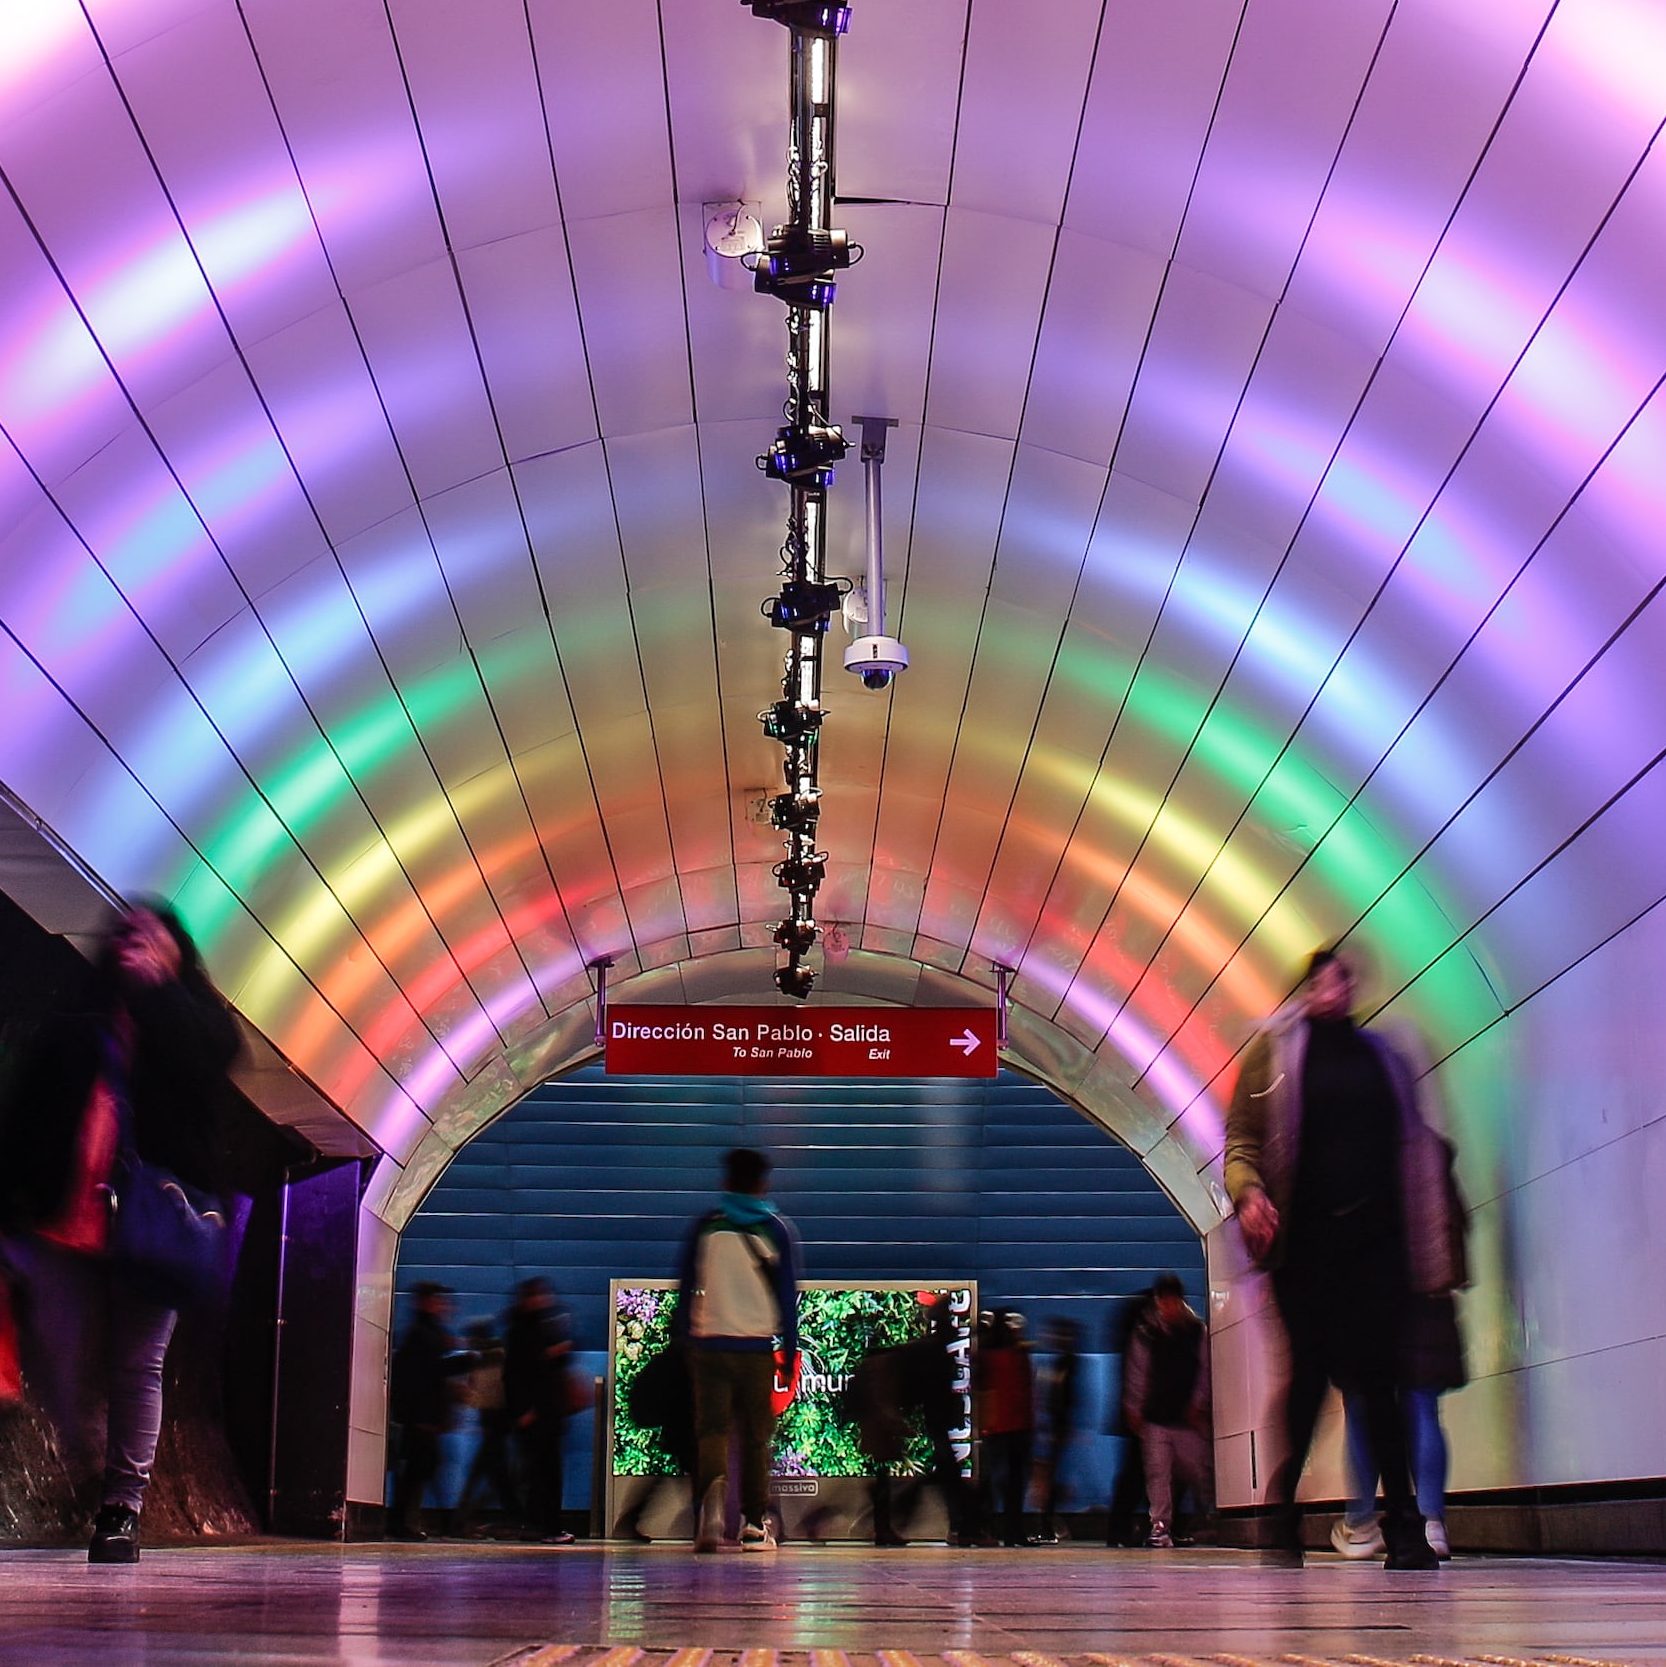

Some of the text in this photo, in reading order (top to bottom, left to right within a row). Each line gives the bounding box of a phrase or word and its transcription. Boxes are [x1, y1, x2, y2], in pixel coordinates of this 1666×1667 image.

[611, 1021, 891, 1043] Dirección San Pablo Salida
[732, 1046, 891, 1061] To San Pablo Exit
